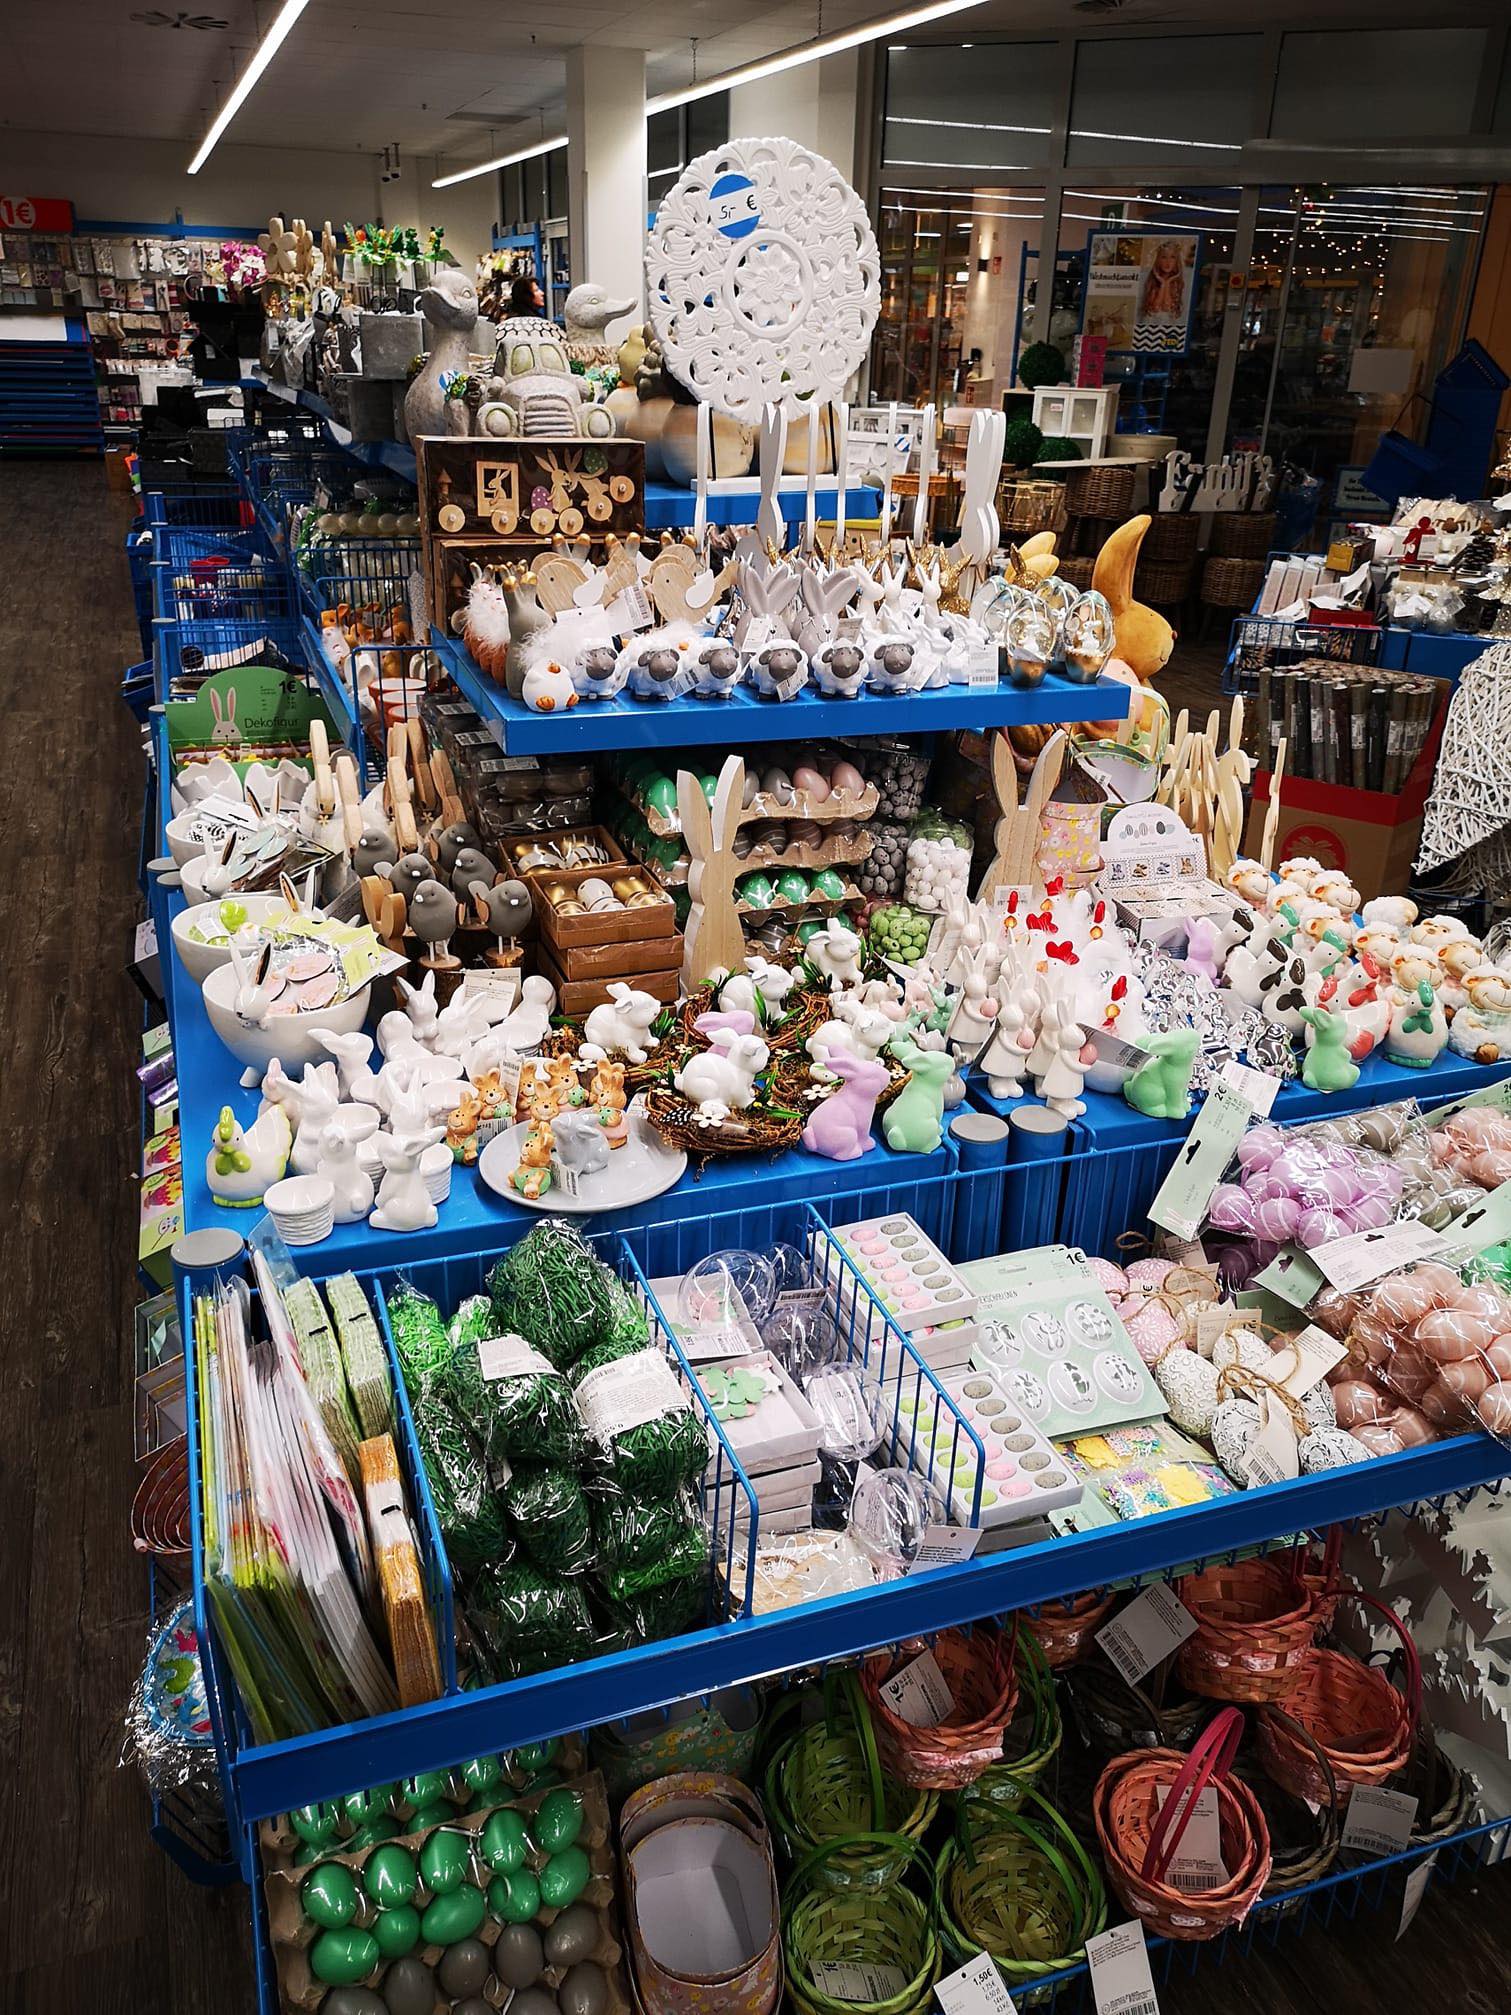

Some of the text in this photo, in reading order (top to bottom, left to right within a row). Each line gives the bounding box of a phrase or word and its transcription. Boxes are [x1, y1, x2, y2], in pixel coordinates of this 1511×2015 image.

[746, 194, 757, 211] €
[2, 199, 33, 225] 1€
[278, 680, 297, 694] 1€
[244, 716, 299, 729] Dekofigur
[1214, 1085, 1227, 1101] 2€
[1066, 1251, 1085, 1265] 1€
[1142, 1284, 1153, 1299] 1€
[888, 1681, 904, 1703] 1€
[973, 1967, 993, 1986] 1,50€
